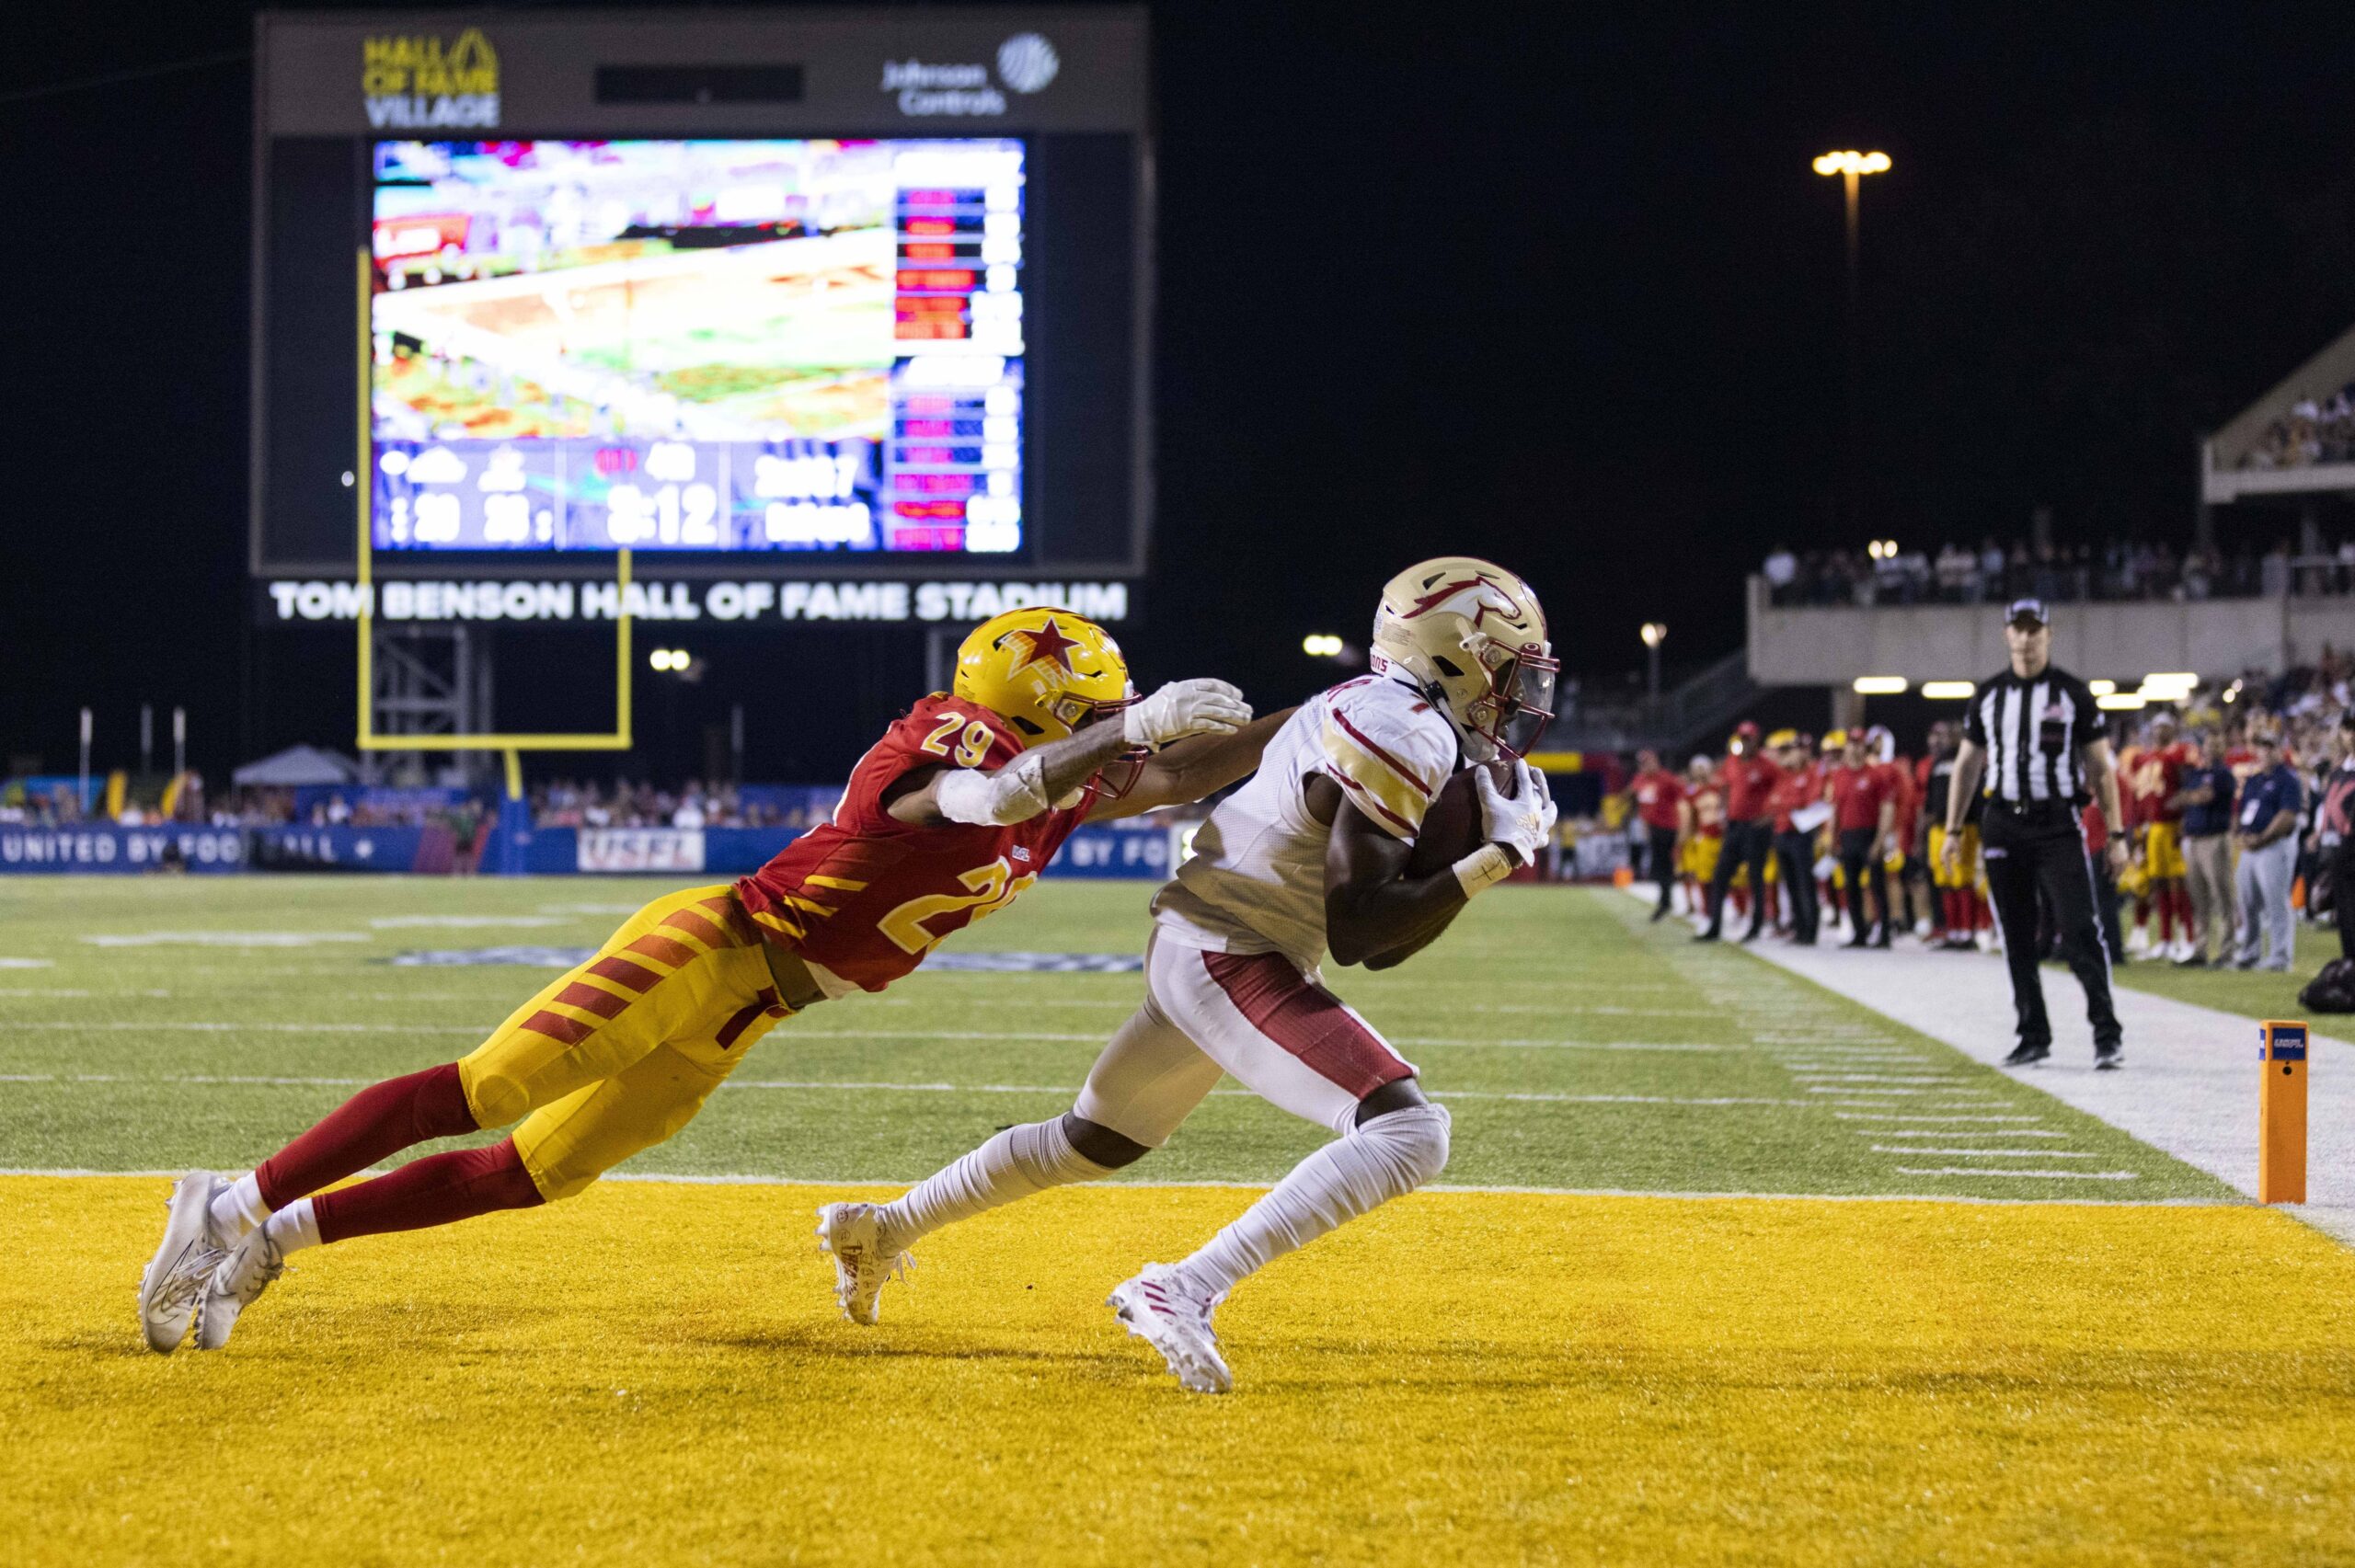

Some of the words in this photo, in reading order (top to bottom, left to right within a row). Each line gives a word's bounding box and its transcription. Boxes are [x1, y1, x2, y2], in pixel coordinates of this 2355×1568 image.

[364, 37, 445, 65] HALL
[362, 66, 405, 96] OF
[879, 59, 988, 91] Johnson
[364, 93, 501, 129] VILLAGE
[898, 86, 1007, 116] Controls
[270, 581, 373, 621] TOM
[381, 581, 575, 621] BENSON
[580, 581, 700, 621] HALL
[706, 581, 775, 621] OF
[780, 581, 911, 621] FAME
[914, 581, 1128, 621] STADIUM
[920, 712, 994, 768] 29
[2, 832, 117, 864] UNITED
[127, 832, 168, 863] BY
[1071, 837, 1114, 867] BY
